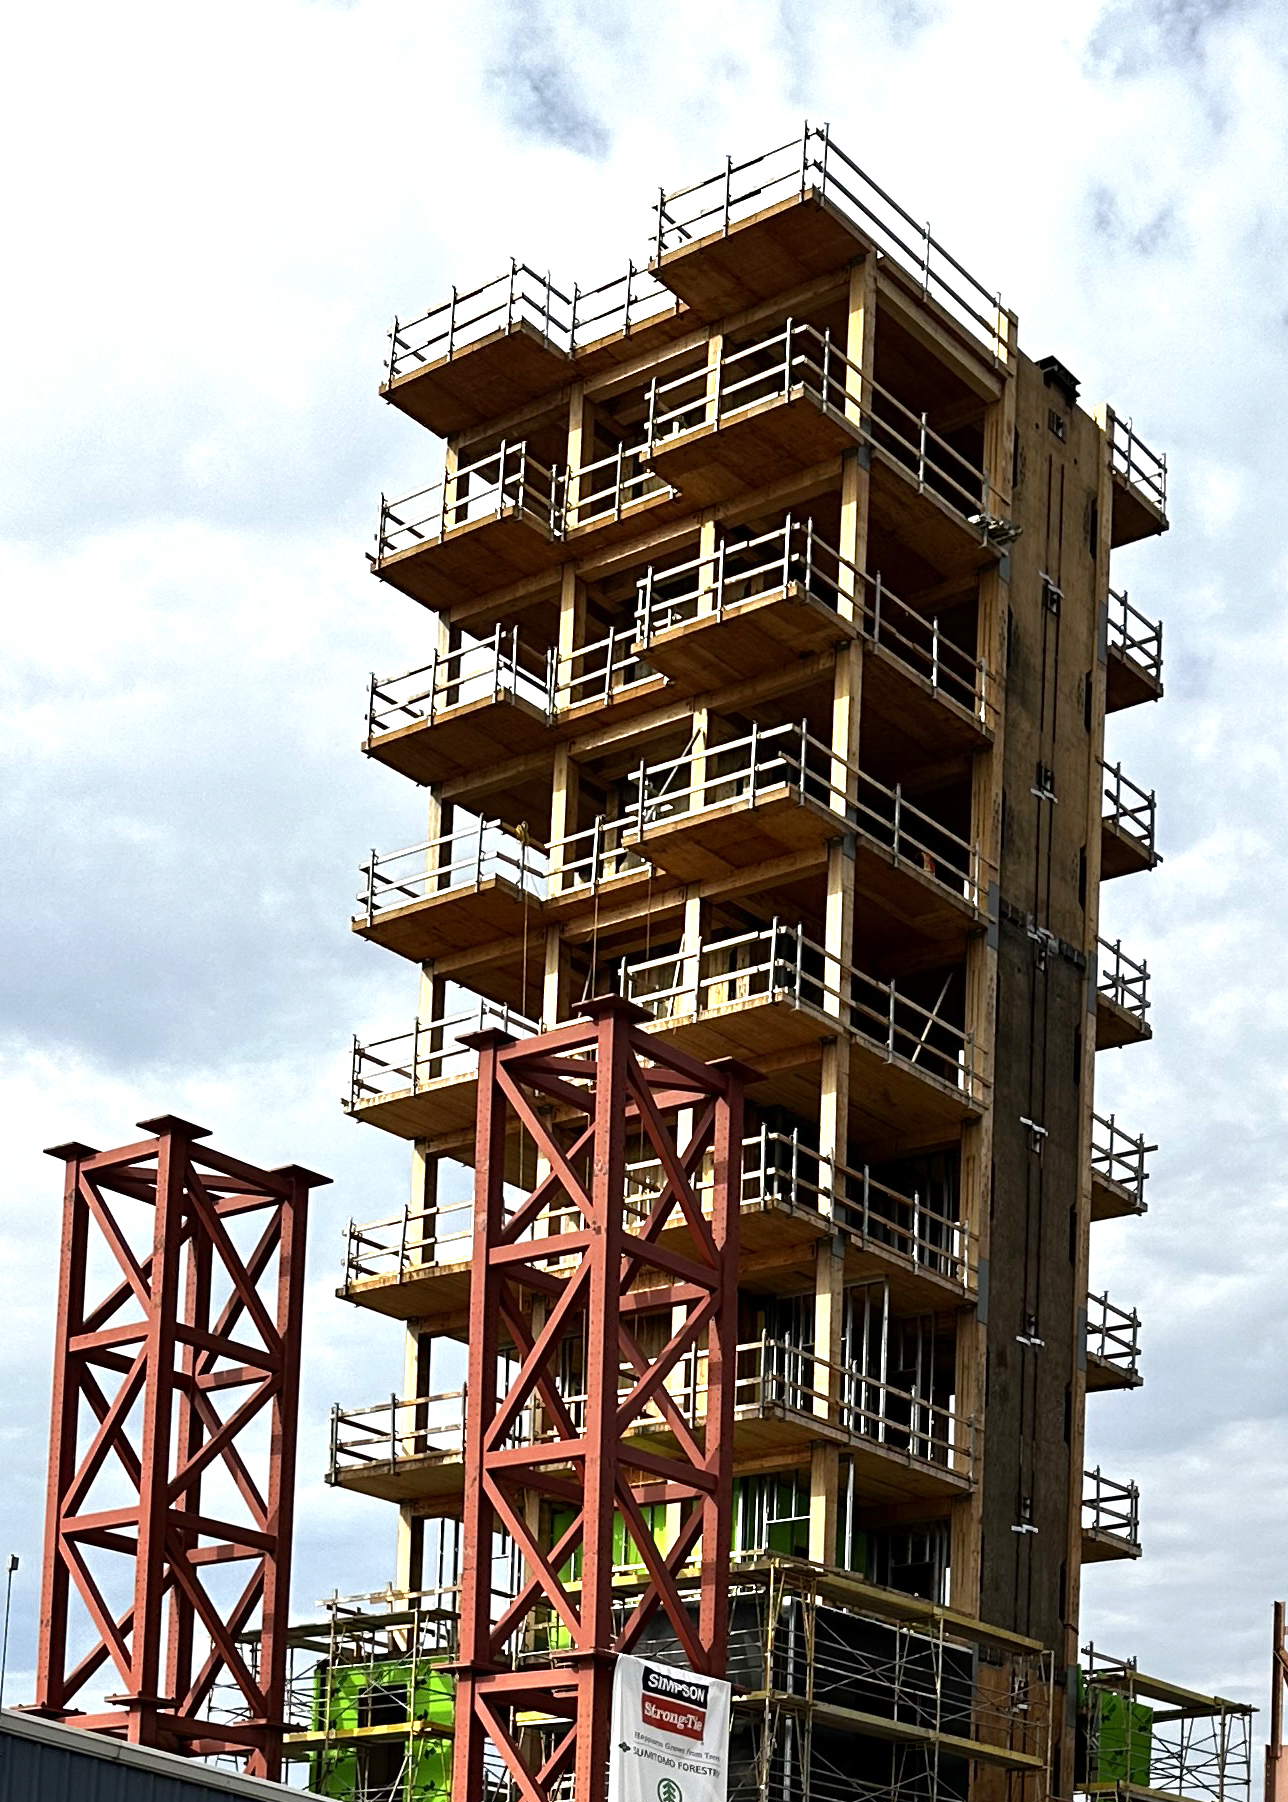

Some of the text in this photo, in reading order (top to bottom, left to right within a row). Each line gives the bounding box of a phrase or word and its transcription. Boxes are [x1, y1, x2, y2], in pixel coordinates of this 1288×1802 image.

[648, 1673, 705, 1703] SIMPSON
[633, 1746, 721, 1779] SUMITOMO FORESTRY
